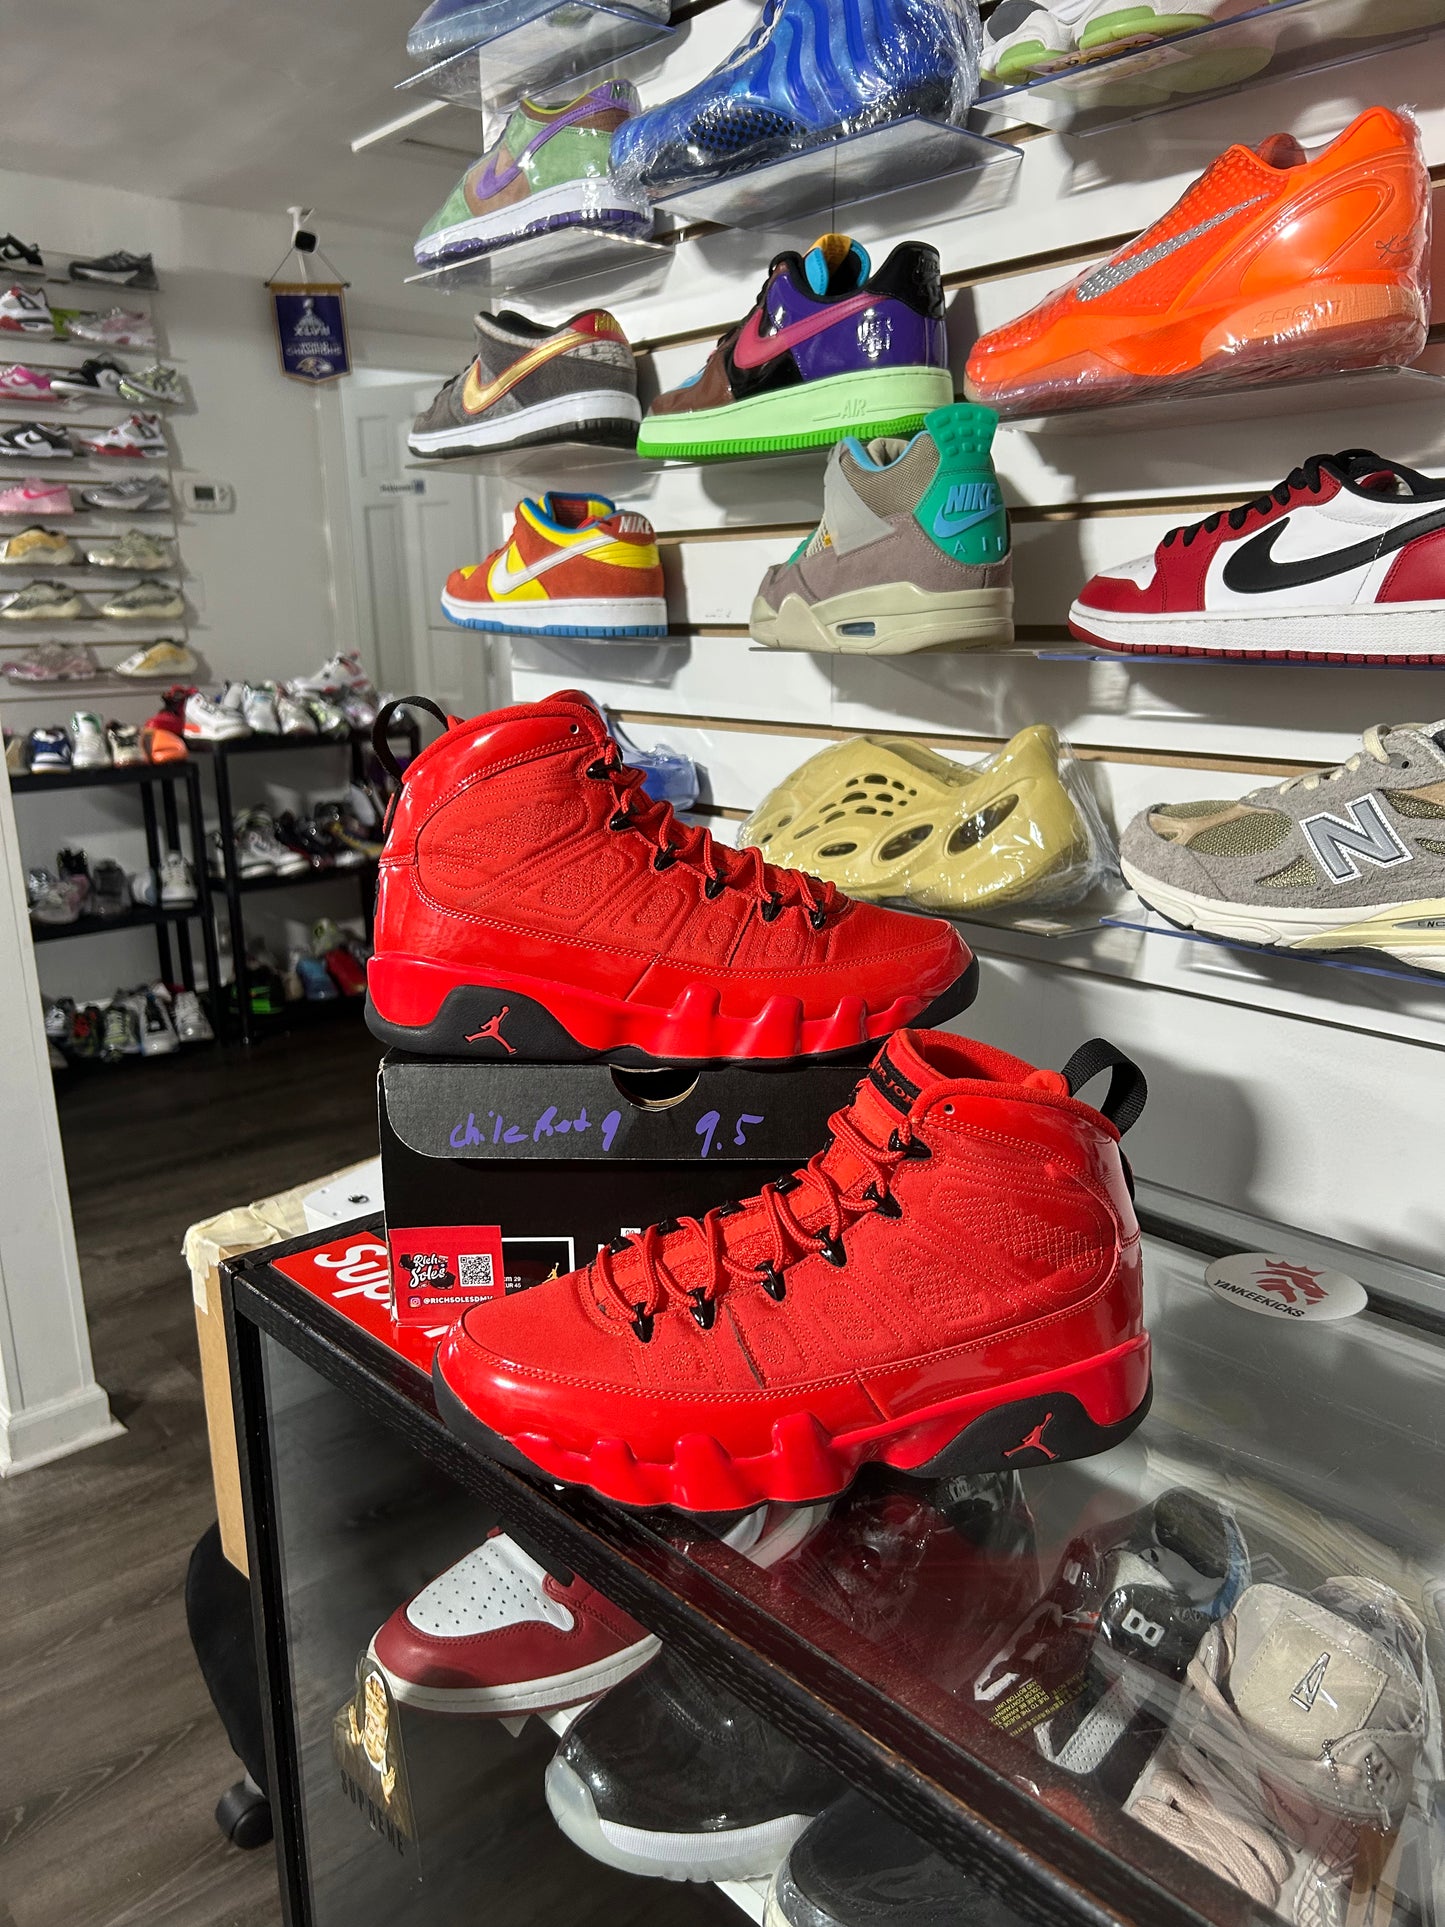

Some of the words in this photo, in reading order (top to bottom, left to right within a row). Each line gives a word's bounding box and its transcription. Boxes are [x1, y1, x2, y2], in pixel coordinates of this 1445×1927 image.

[841, 399, 867, 420] AIR
[945, 483, 997, 515] NIKE
[602, 1110, 622, 1152] 9
[696, 1110, 765, 1158] 9.5
[413, 1253, 438, 1268] Rich
[313, 1243, 392, 1310] Sup
[409, 1266, 446, 1288] Soles
[1213, 1279, 1306, 1318] YANKEEKICKS
[1121, 1608, 1165, 1648] 8
[1004, 1686, 1027, 1703] BOTTOM
[1022, 1684, 1041, 1699] COLOR
[1024, 1689, 1045, 1705] PLEASE
[1037, 1694, 1050, 1705] DUE
[1017, 1701, 1027, 1710] BE
[1018, 1706, 1031, 1717] THE
[1029, 1701, 1038, 1710] TO
[999, 1706, 1019, 1722] AWARE
